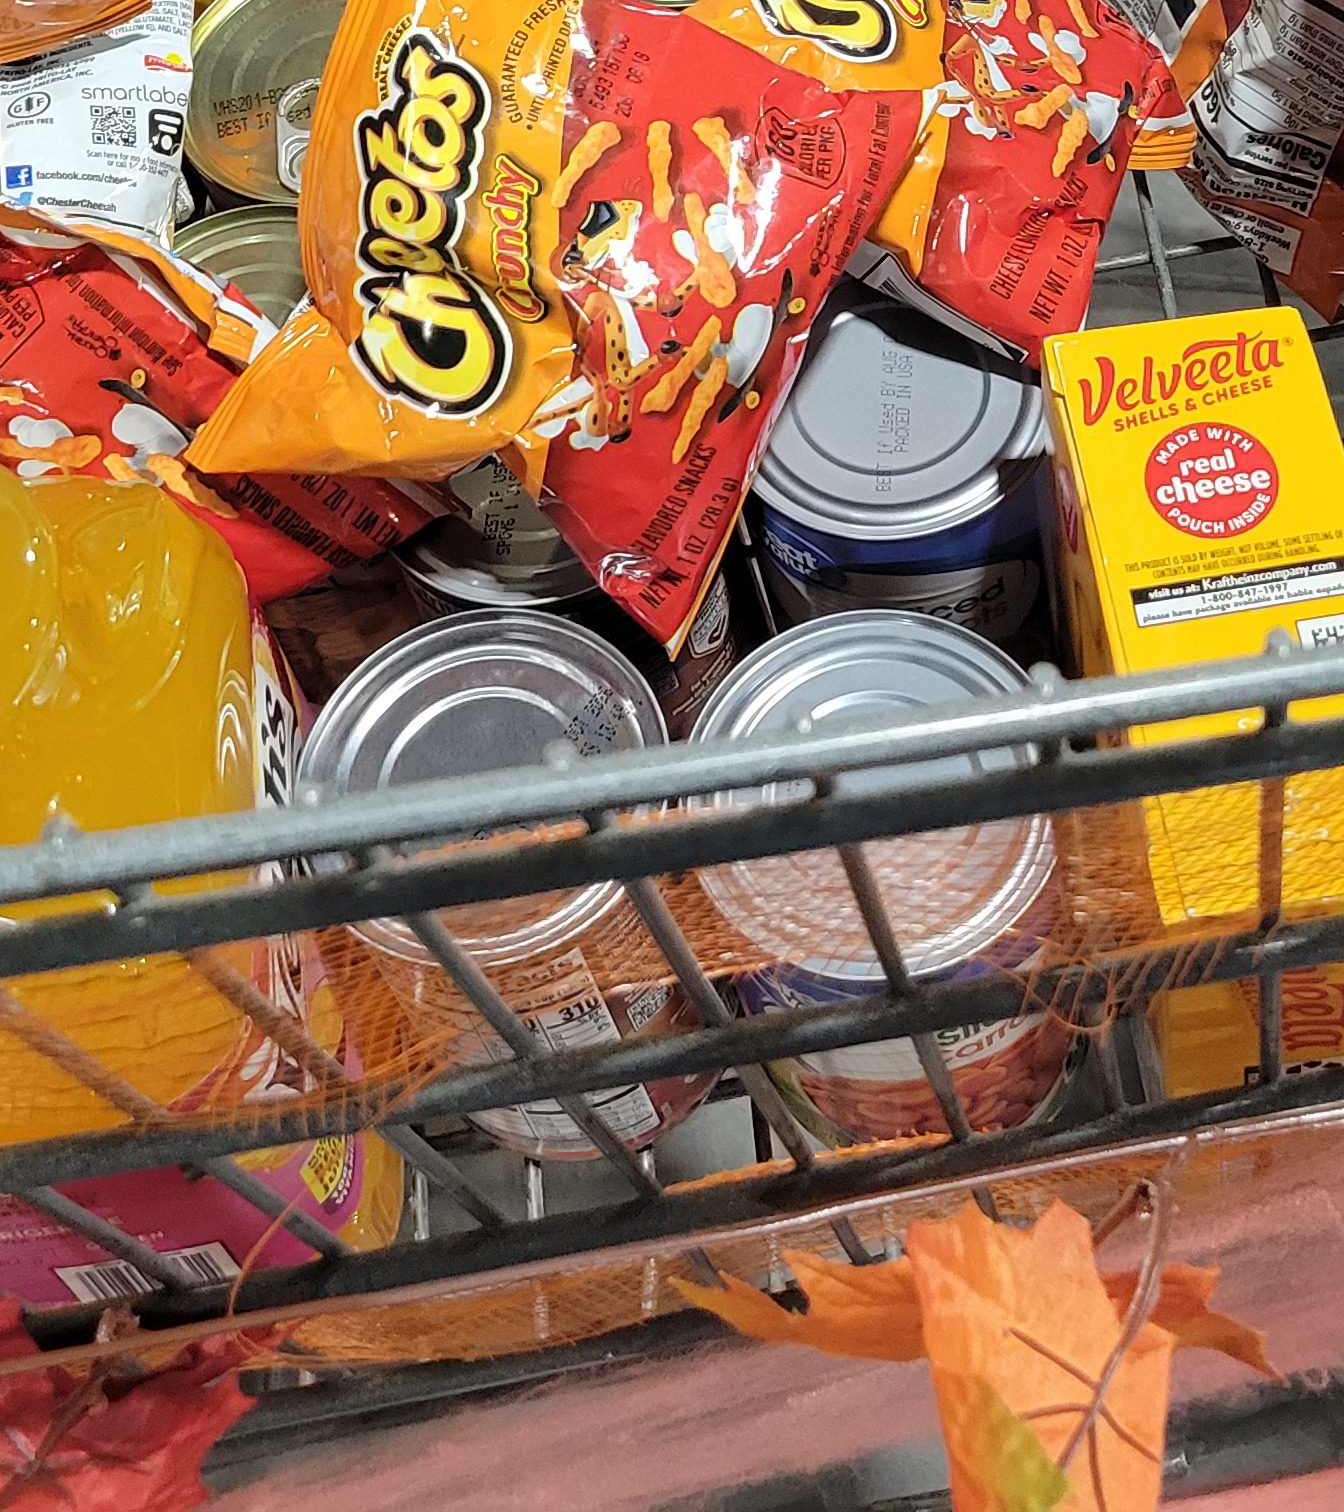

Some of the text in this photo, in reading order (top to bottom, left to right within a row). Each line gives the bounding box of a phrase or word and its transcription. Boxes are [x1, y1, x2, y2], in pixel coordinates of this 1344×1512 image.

[501, 28, 530, 125] GUARANTEED
[217, 119, 248, 139] BEST
[359, 43, 504, 406] Cheetos
[495, 154, 542, 321] Crunchy
[894, 354, 914, 453] PACKED IN USA
[1077, 331, 1284, 426] Velveeta
[1113, 375, 1273, 433] SHELLS & CHEESE
[1155, 427, 1254, 465] MADE WITH
[1179, 447, 1236, 477] real
[1156, 469, 1272, 505] cheese
[1167, 492, 1271, 534] POUCH INSIDE
[1200, 581, 1289, 605] 1-800-847-1997
